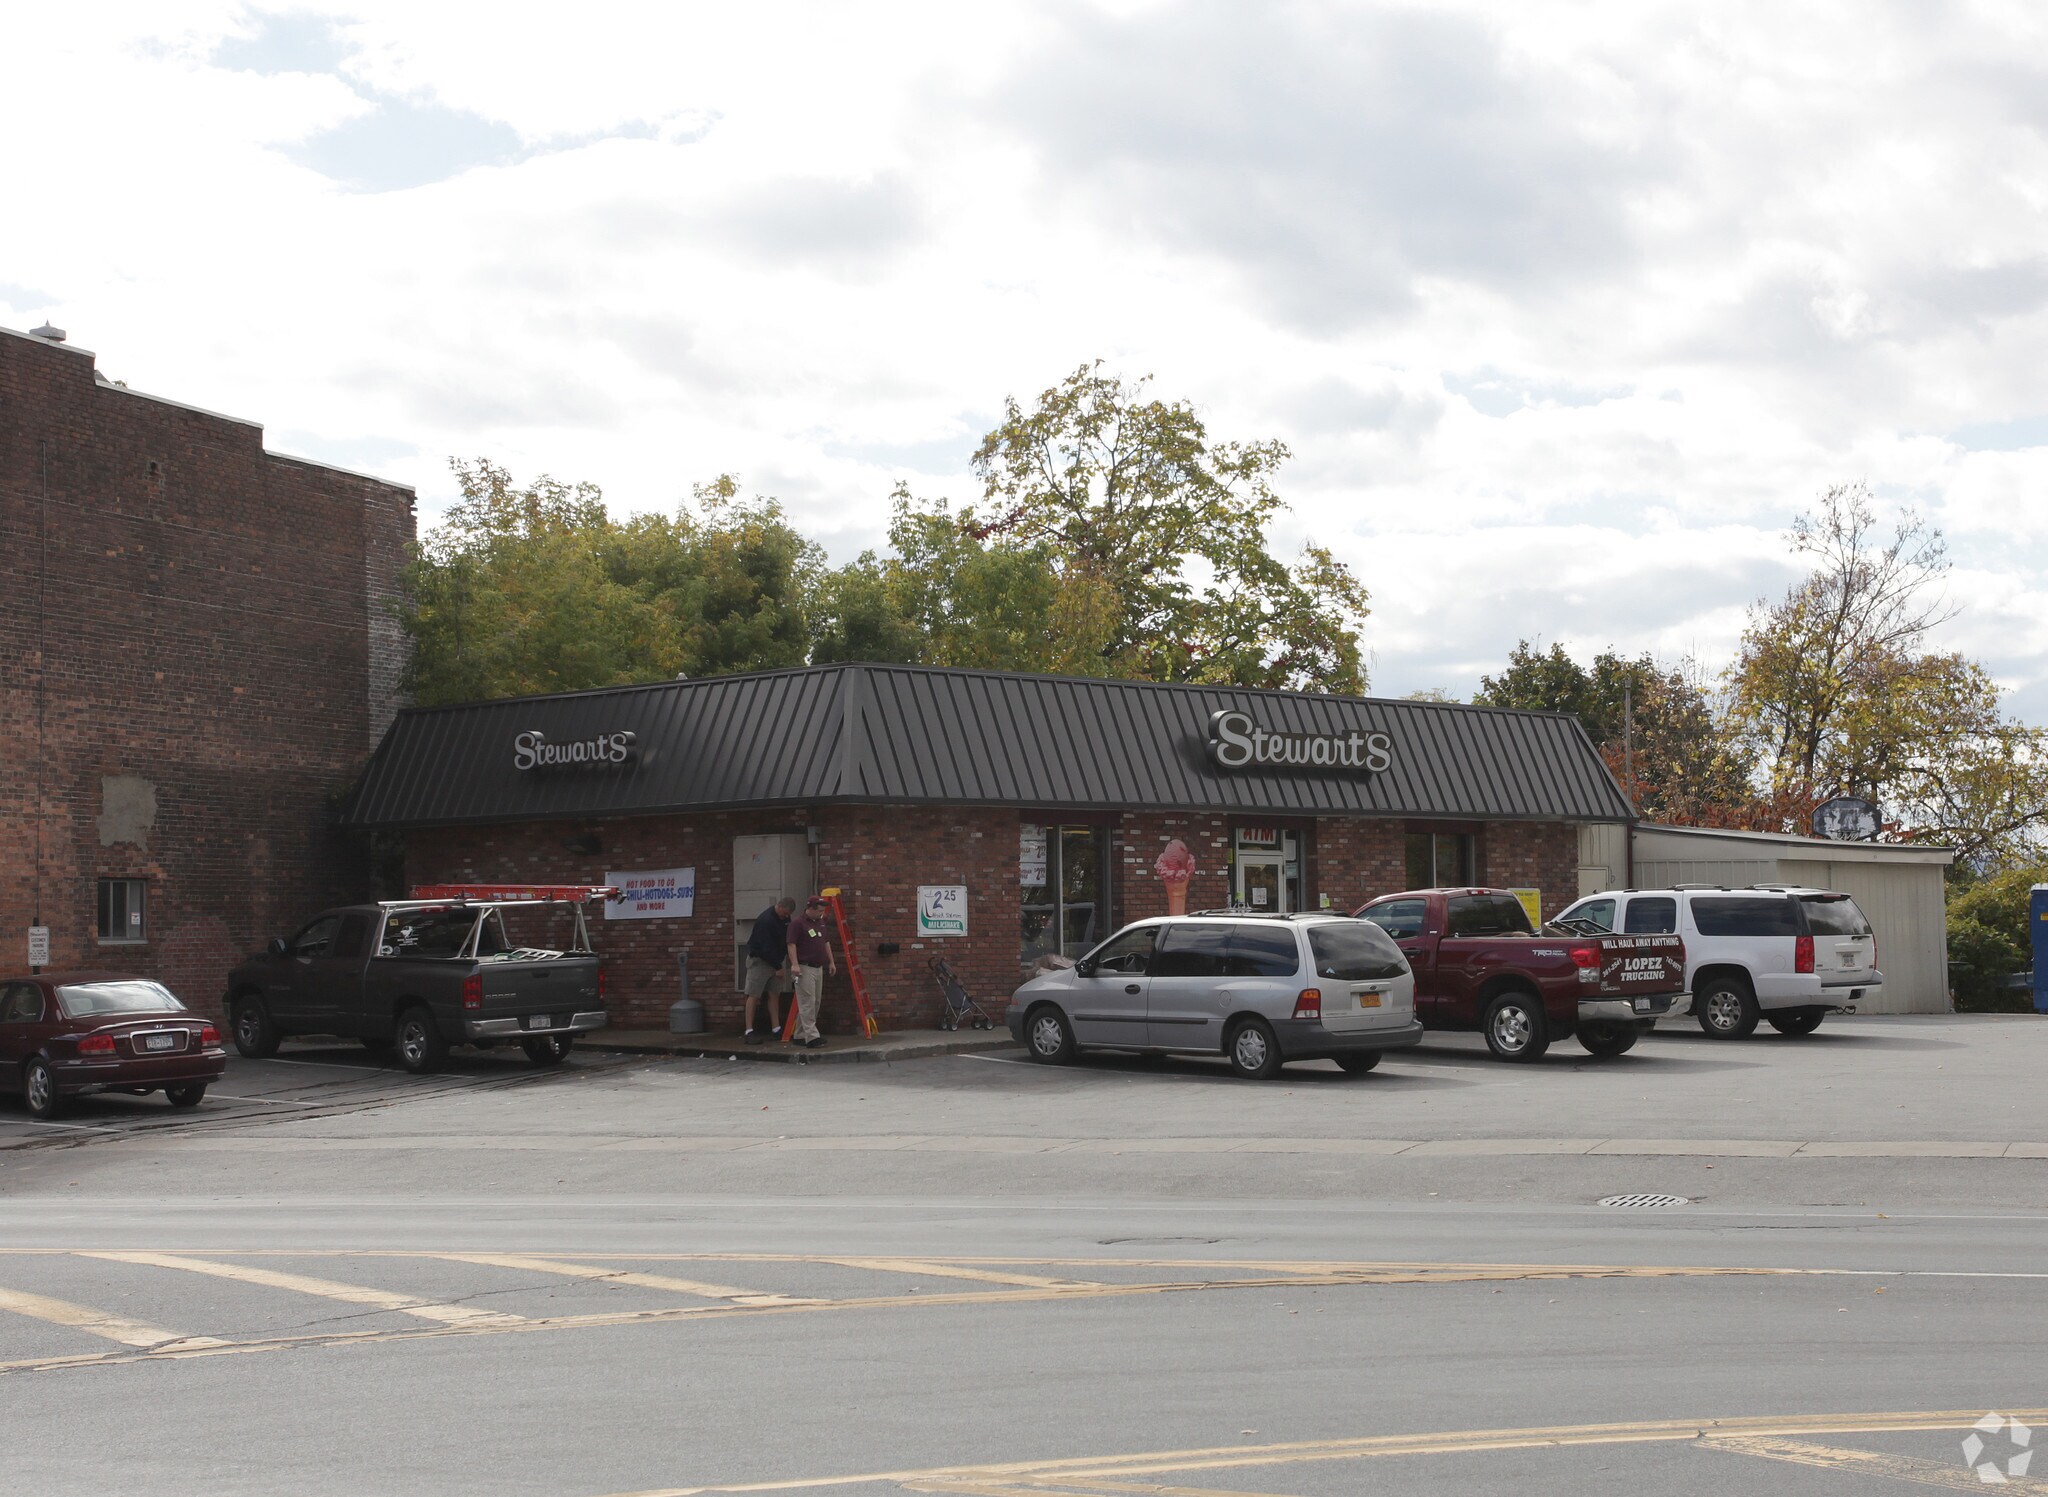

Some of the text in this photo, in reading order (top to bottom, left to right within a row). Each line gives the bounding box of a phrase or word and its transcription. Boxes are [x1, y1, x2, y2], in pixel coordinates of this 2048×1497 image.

[626, 878, 675, 889] HOT FOOD TO GO
[636, 902, 665, 911] AND MORE
[928, 921, 961, 929] MILKSHAKE
[1602, 937, 1679, 949] WILL HAUL AWAY ANYTHING
[1624, 957, 1662, 971] LOPEZ
[1620, 970, 1665, 982] TRUCKING
